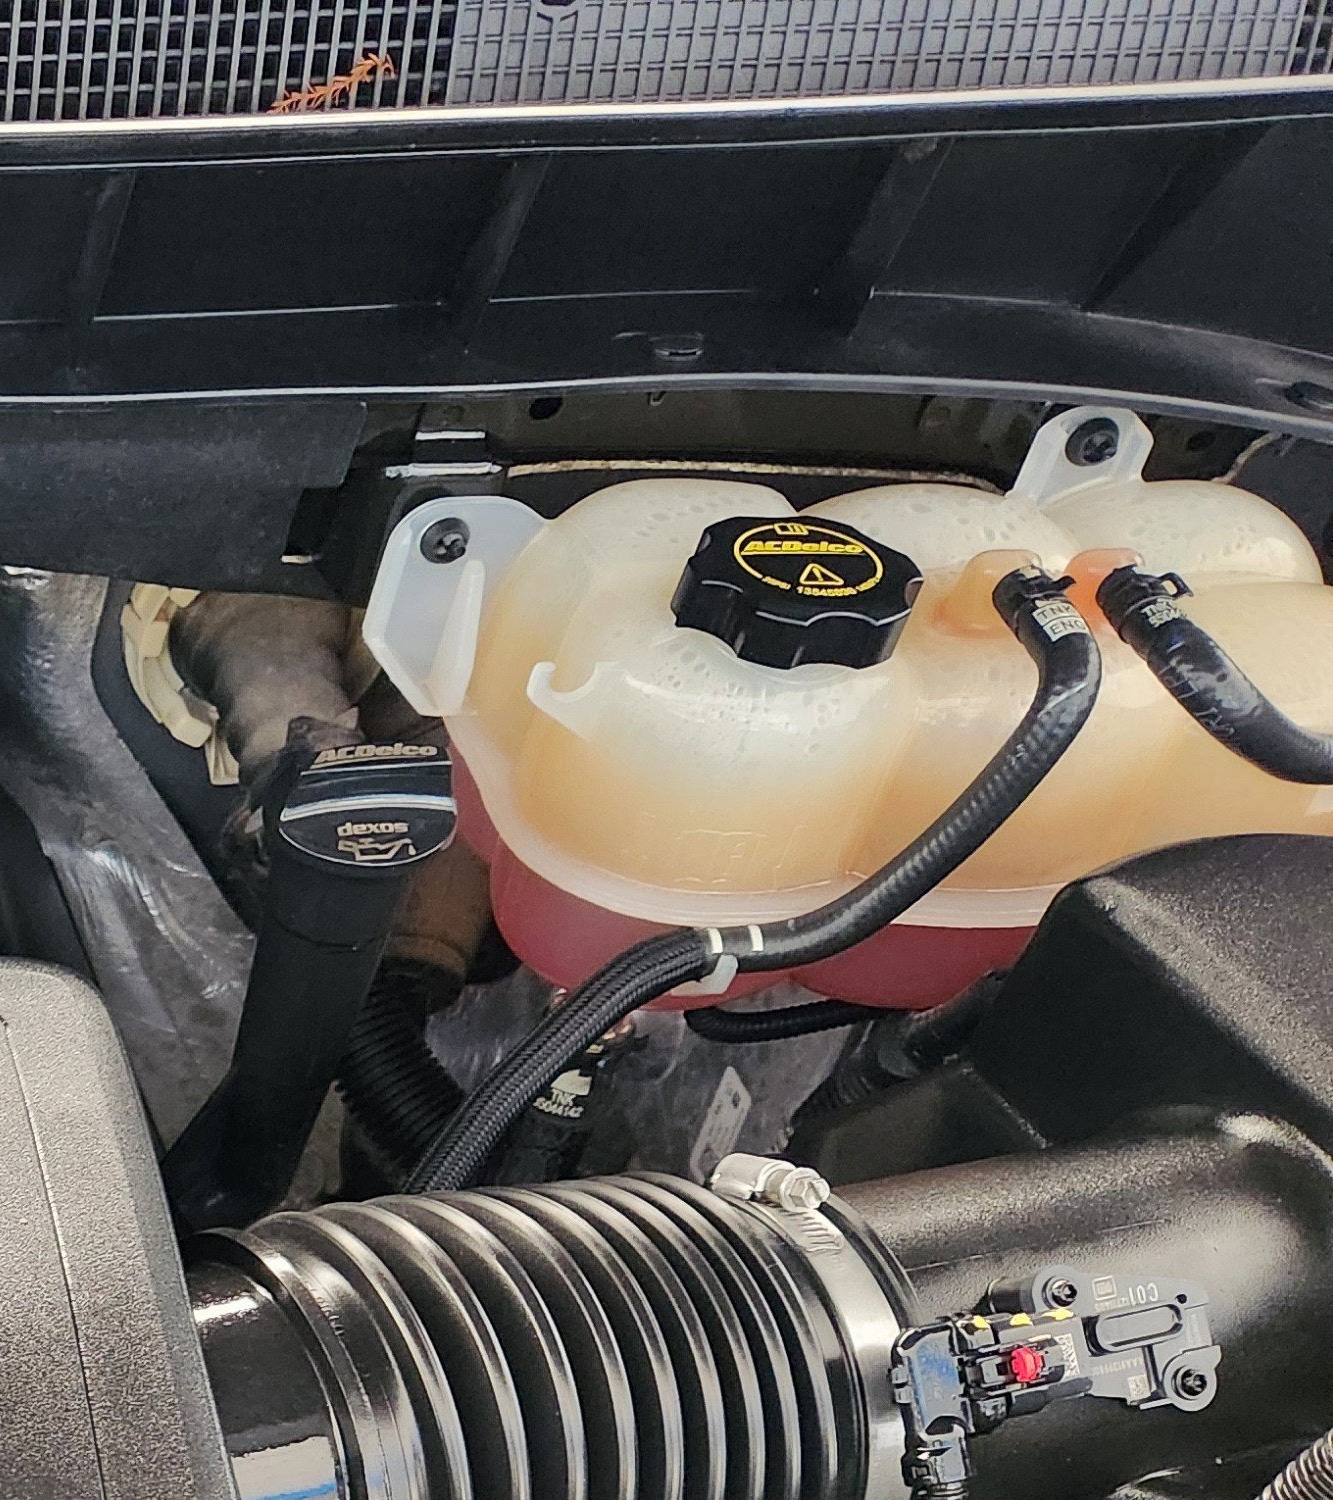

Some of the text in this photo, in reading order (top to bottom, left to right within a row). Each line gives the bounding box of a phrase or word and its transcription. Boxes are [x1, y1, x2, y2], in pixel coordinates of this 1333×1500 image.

[742, 540, 865, 553] ACDelco
[313, 742, 438, 765] ACDelco
[337, 822, 409, 837] dexos
